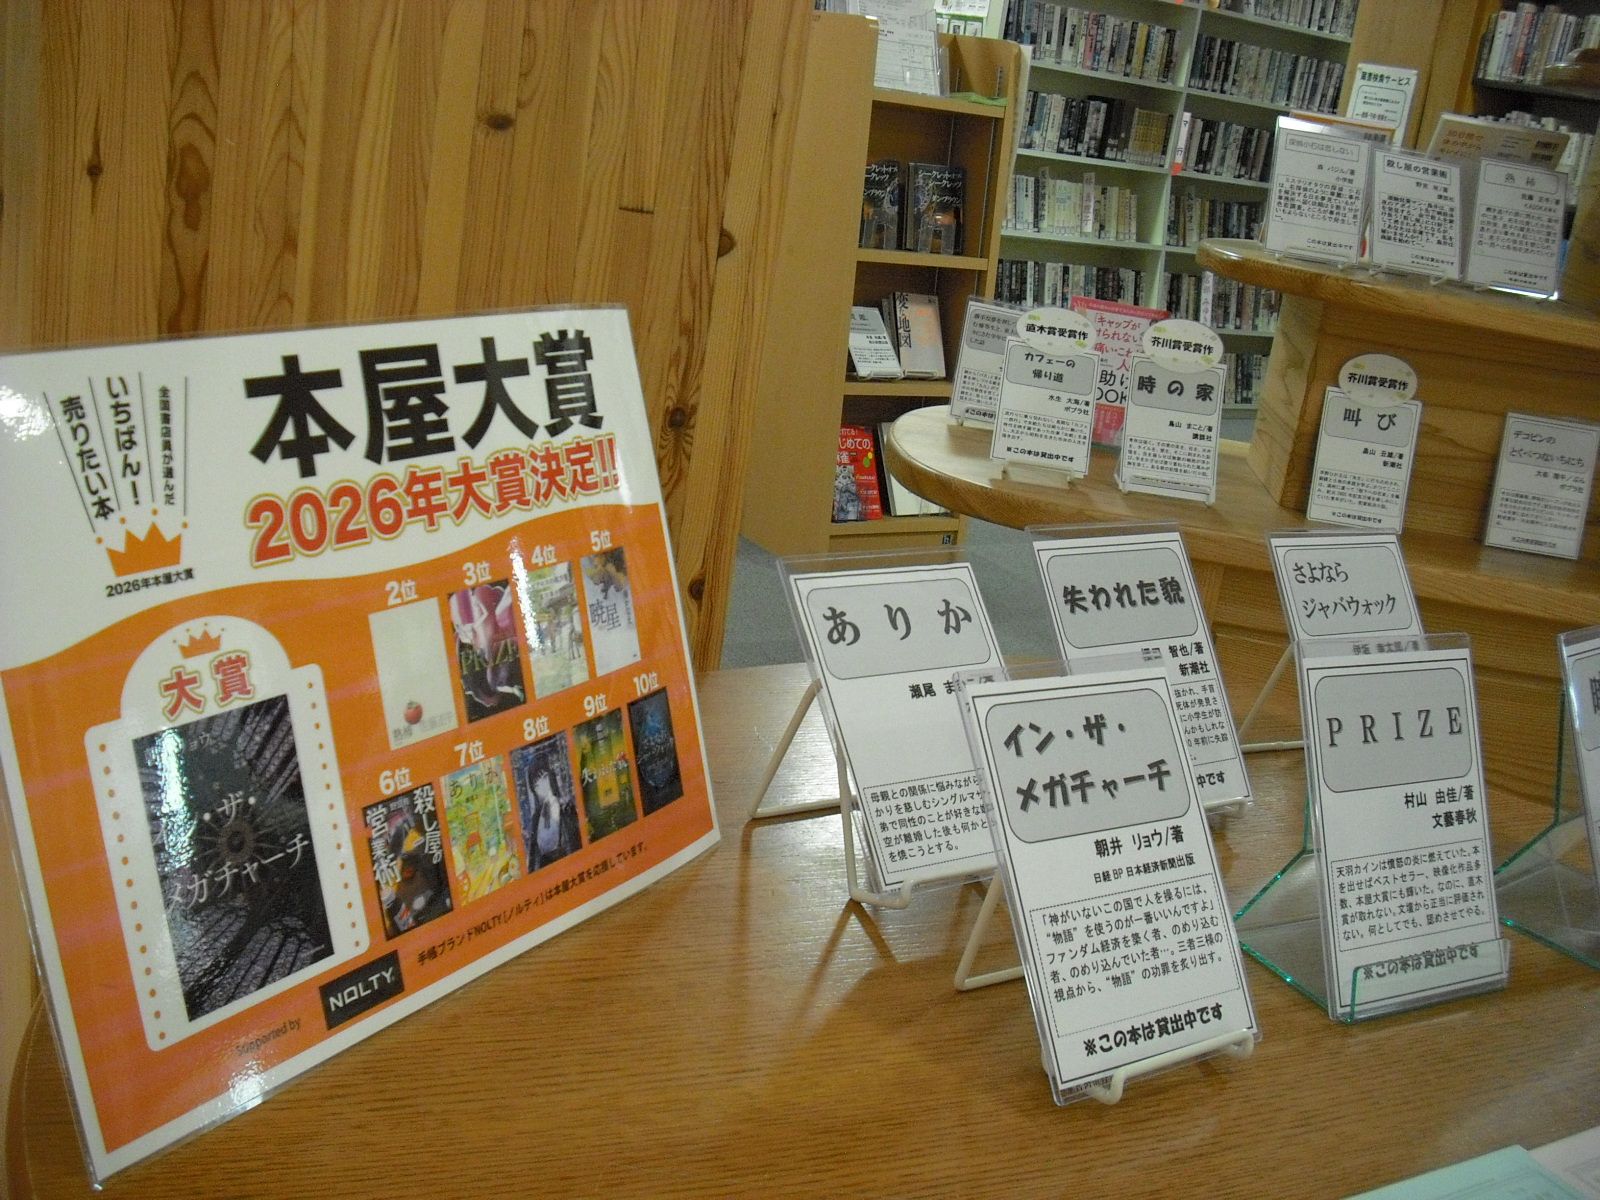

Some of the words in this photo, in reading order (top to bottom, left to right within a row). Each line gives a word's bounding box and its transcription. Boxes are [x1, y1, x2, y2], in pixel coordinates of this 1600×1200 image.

[1026, 323, 1089, 341] 直木賞受賞作
[1151, 336, 1214, 355] 芥川賞受賞作
[1025, 352, 1076, 368] カフェーの
[1137, 375, 1214, 402] 時の家
[1348, 372, 1408, 391] 芥川賞受賞作
[243, 329, 604, 478] 本屋大賞
[1343, 408, 1397, 431] 叫び
[60, 396, 114, 520] 売りたい本
[591, 528, 612, 552] 5位
[531, 545, 557, 566] 4位
[105, 567, 194, 598] 2026年本屋大賞
[462, 560, 492, 585] 3位
[1292, 561, 1349, 584] さよなら
[385, 580, 420, 606] 2位
[1062, 576, 1186, 615] 失われた貌
[1302, 593, 1398, 619] ジャバウォック
[1168, 641, 1205, 659] 智也/著
[1178, 660, 1211, 677] 新潮社
[162, 652, 253, 718] 大賞
[633, 672, 659, 696] 10位
[908, 682, 937, 700] 瀬尾
[584, 693, 608, 716] 9位
[523, 715, 550, 741] 8位
[1003, 713, 1127, 757] イン・ザ・
[1326, 706, 1463, 747] PRIZE
[454, 740, 485, 767] 7位
[379, 767, 412, 795] 6位
[1016, 757, 1174, 813] メガチャーチ
[1404, 792, 1427, 809] 村山
[1435, 784, 1475, 805] 由佳/著
[1431, 807, 1478, 829] 文藝春秋
[882, 819, 988, 848] 空が離婚した後も何かと
[1094, 836, 1123, 859] 朝井
[1132, 825, 1185, 851] リョウ/著
[888, 840, 959, 863] を焼こうとする。
[1042, 882, 1208, 927] 「神がいないこの国で人を操るには、
[1046, 914, 1220, 965] ファンダム経済を築く者、のめり込む
[1362, 942, 1479, 981] ※この本は貸出中です
[329, 966, 394, 1011] NOLTY
[1083, 1002, 1223, 1057] ※この本は貸出中です
